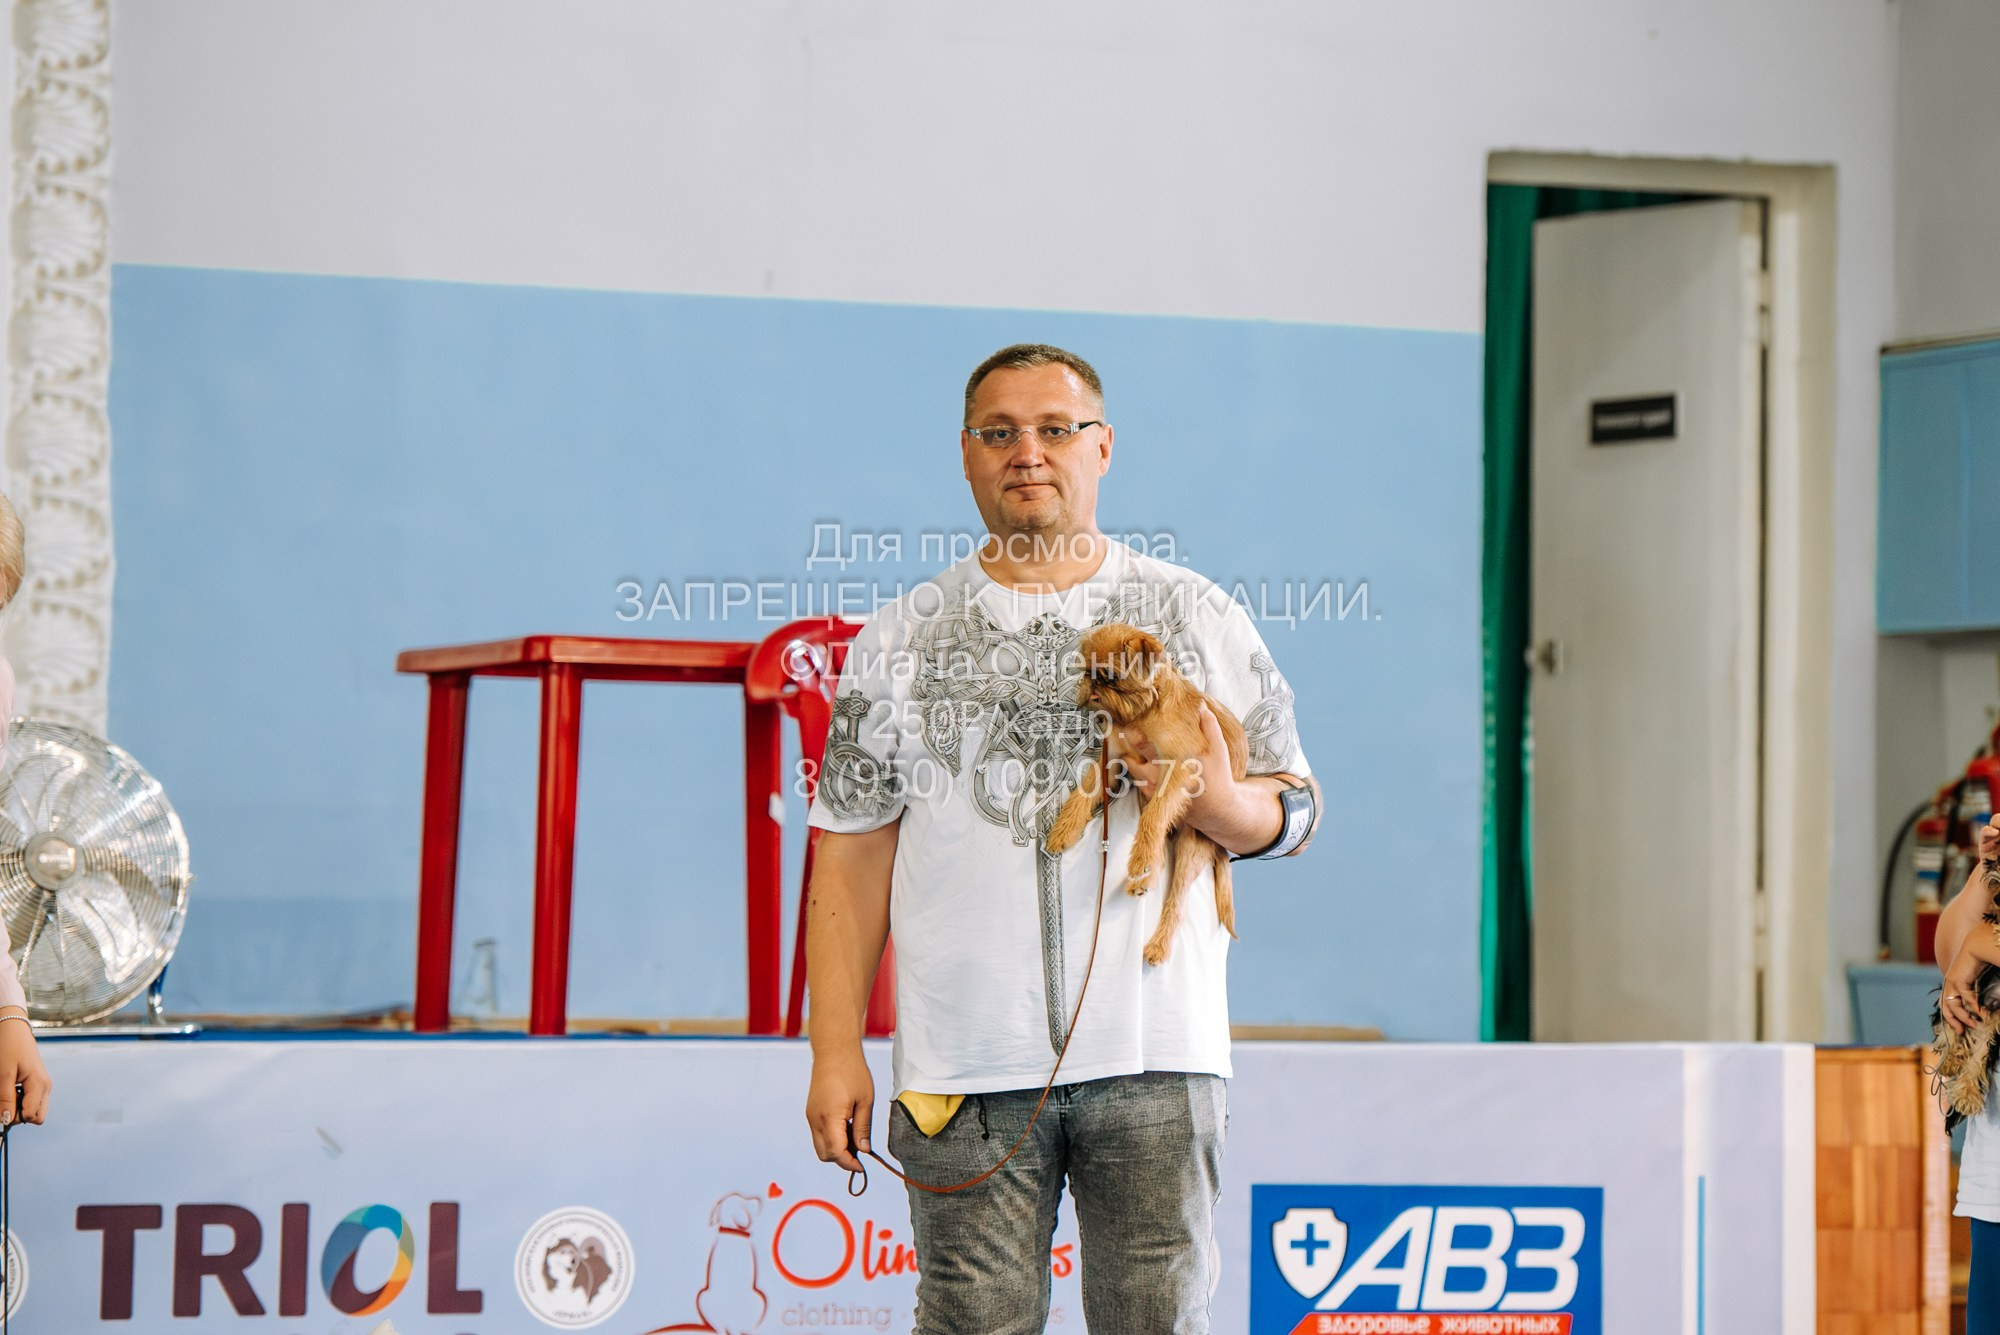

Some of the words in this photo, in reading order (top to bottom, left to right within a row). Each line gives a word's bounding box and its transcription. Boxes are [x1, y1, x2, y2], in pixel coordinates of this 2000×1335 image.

[76, 1201, 484, 1320] TRIOL
[1314, 1206, 1587, 1312] АВЗ
[781, 1303, 892, 1330] clothing
